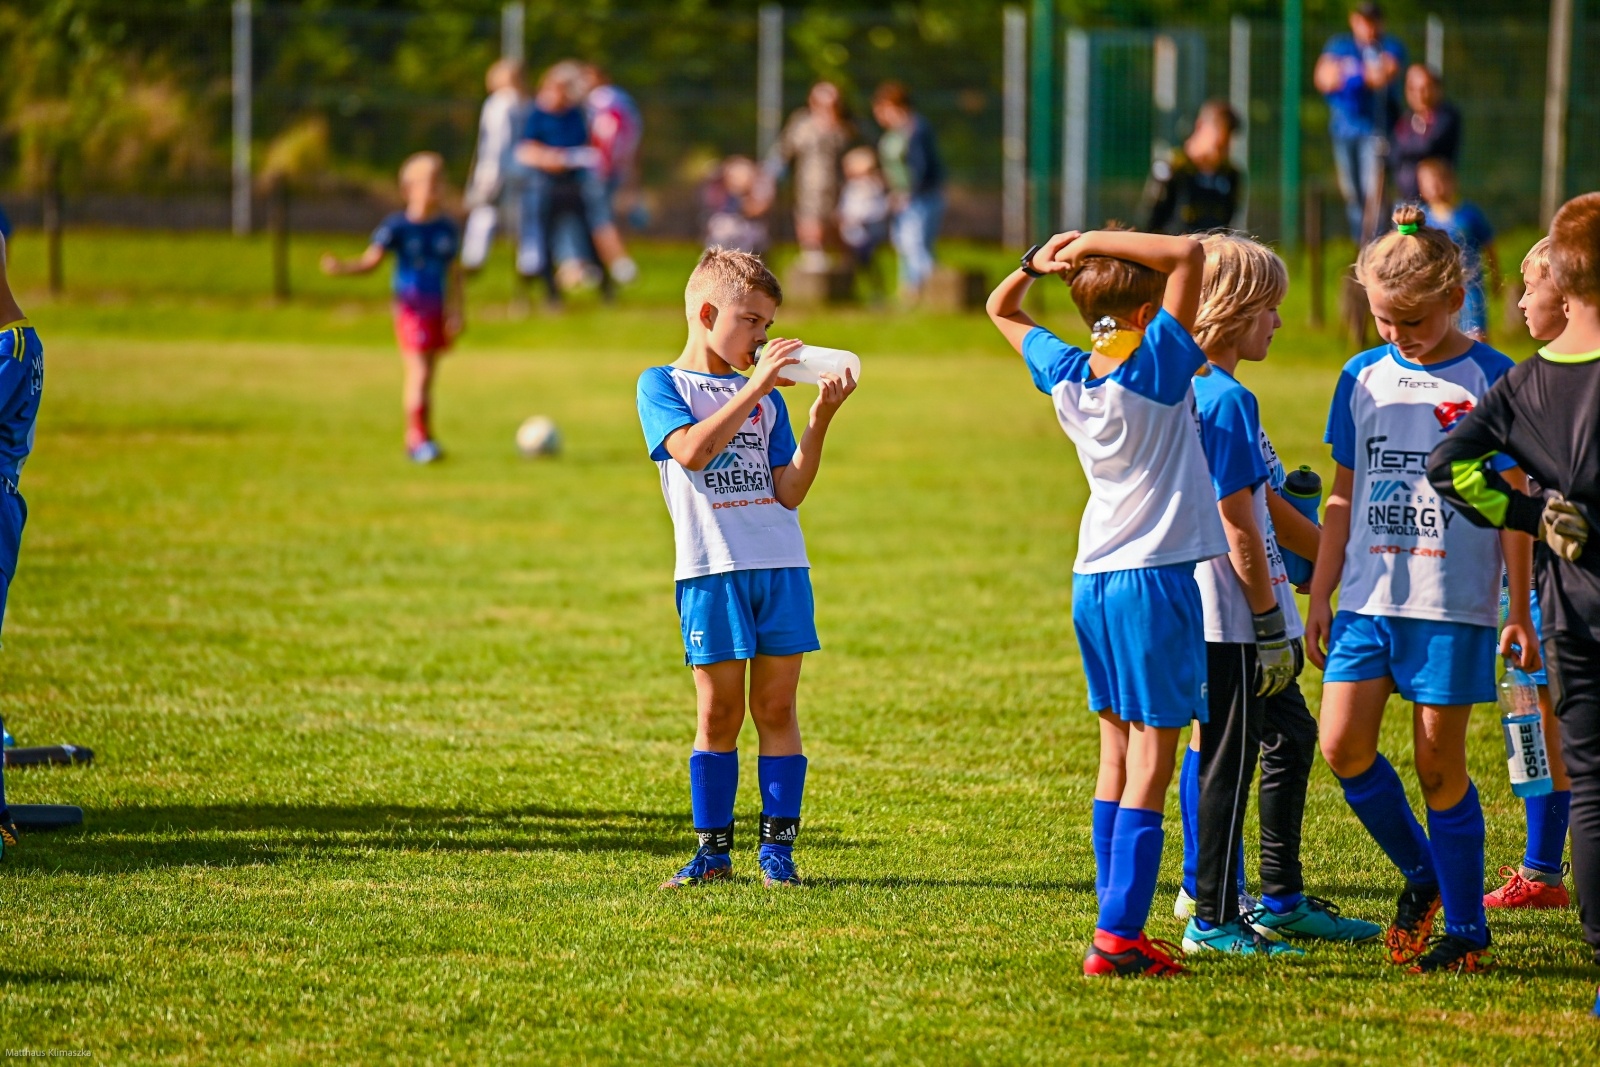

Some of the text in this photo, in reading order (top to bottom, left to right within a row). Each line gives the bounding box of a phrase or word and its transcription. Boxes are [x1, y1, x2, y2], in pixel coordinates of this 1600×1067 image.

[703, 470, 770, 489] ENERGY
[1368, 505, 1455, 530] ENERGY
[1520, 723, 1538, 778] OSHEE
